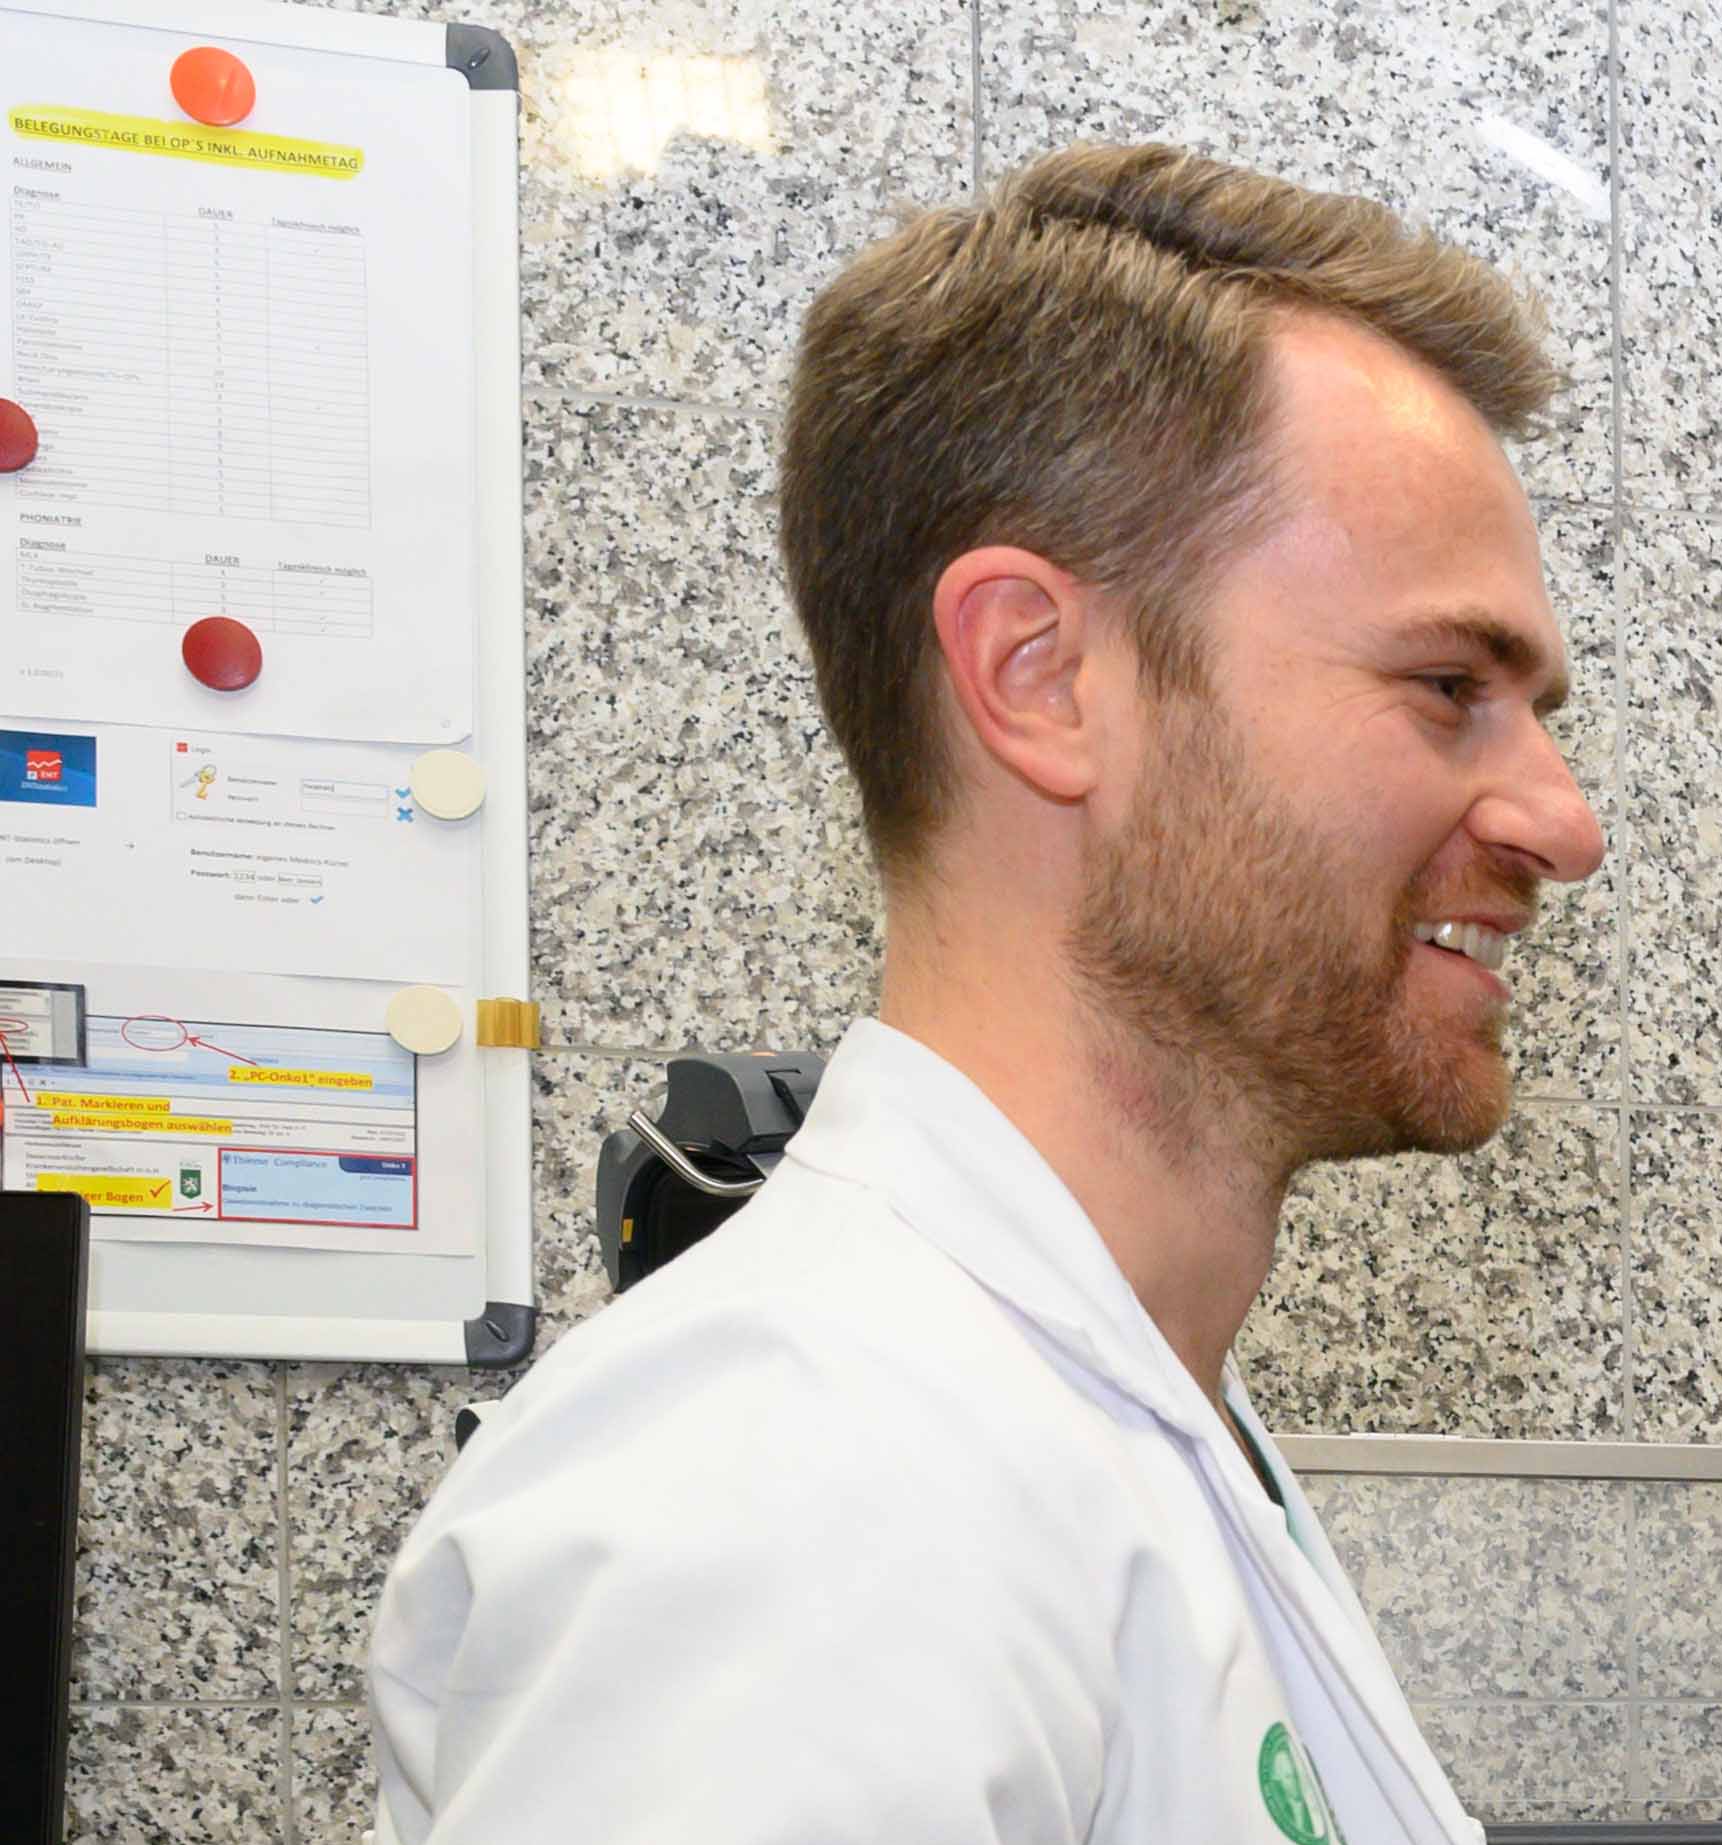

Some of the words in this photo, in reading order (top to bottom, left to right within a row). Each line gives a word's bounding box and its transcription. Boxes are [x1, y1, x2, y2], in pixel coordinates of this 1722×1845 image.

[15, 118, 140, 144] BELEGUNGSTAGE
[144, 134, 166, 146] BEI
[208, 142, 243, 155] INKL.
[247, 146, 359, 169] AUFNAHMETAG
[19, 513, 82, 526] PHONIATRIE
[204, 553, 240, 567] DAUER
[317, 1077, 373, 1089] eingeben
[52, 1096, 76, 1108] Pat.
[80, 1098, 144, 1111] Markieren
[147, 1101, 170, 1112] und
[53, 1114, 164, 1130] Aufklärungsbogen
[167, 1119, 232, 1133] auswählen
[273, 1156, 328, 1169] Compliance
[105, 1190, 144, 1203] Bogen
